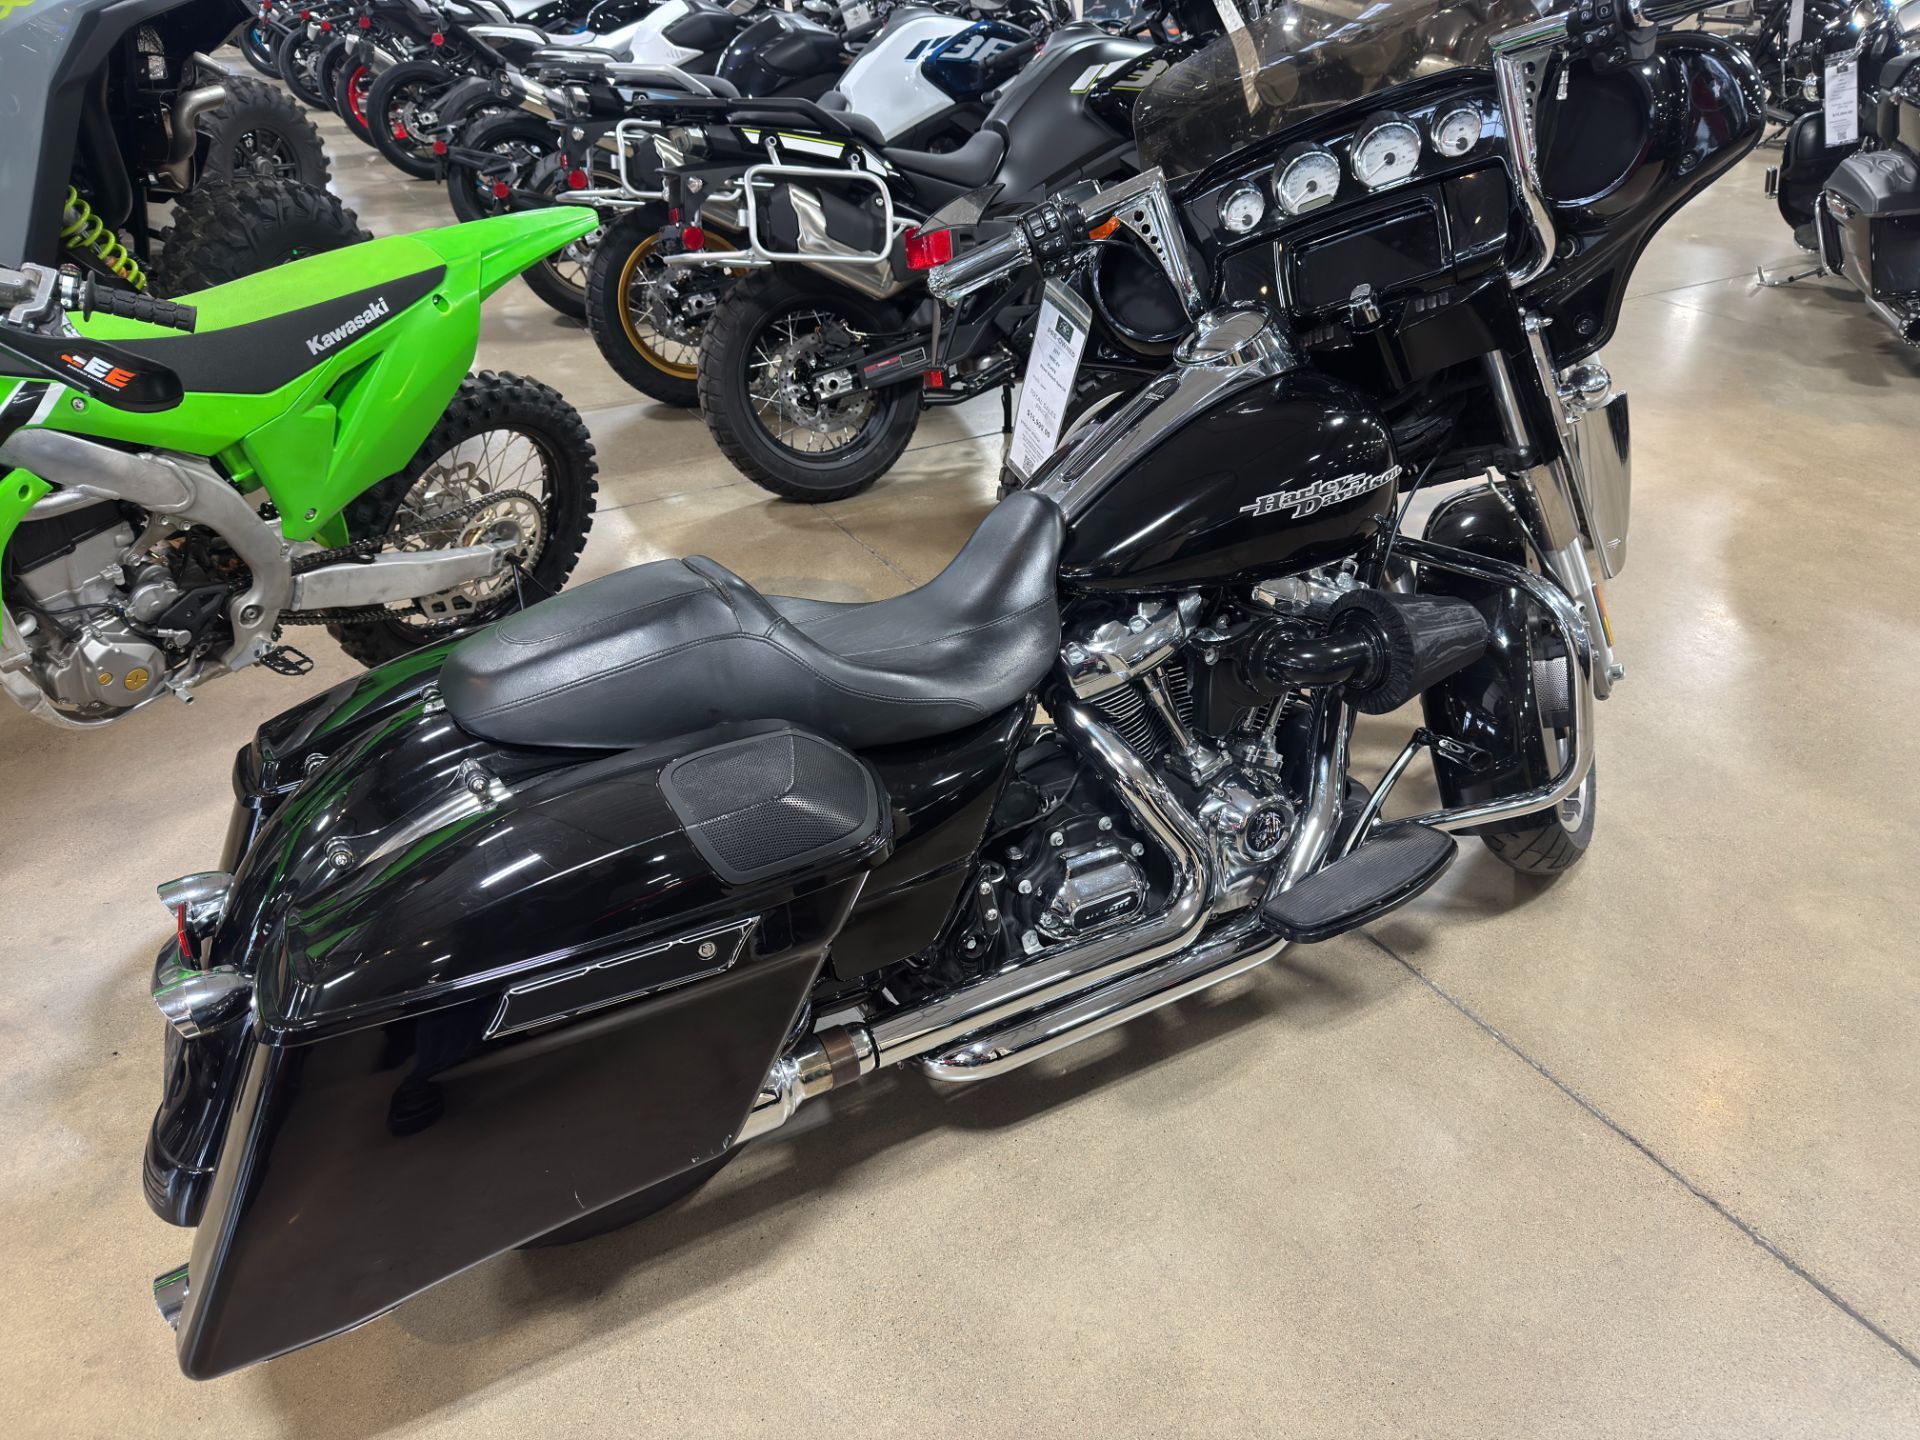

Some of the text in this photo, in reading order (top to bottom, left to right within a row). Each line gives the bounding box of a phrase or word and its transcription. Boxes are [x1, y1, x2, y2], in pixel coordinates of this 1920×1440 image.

[305, 297, 389, 355] Kawasaki
[1239, 474, 1366, 516] Harley
[1291, 465, 1402, 519] Davidson
